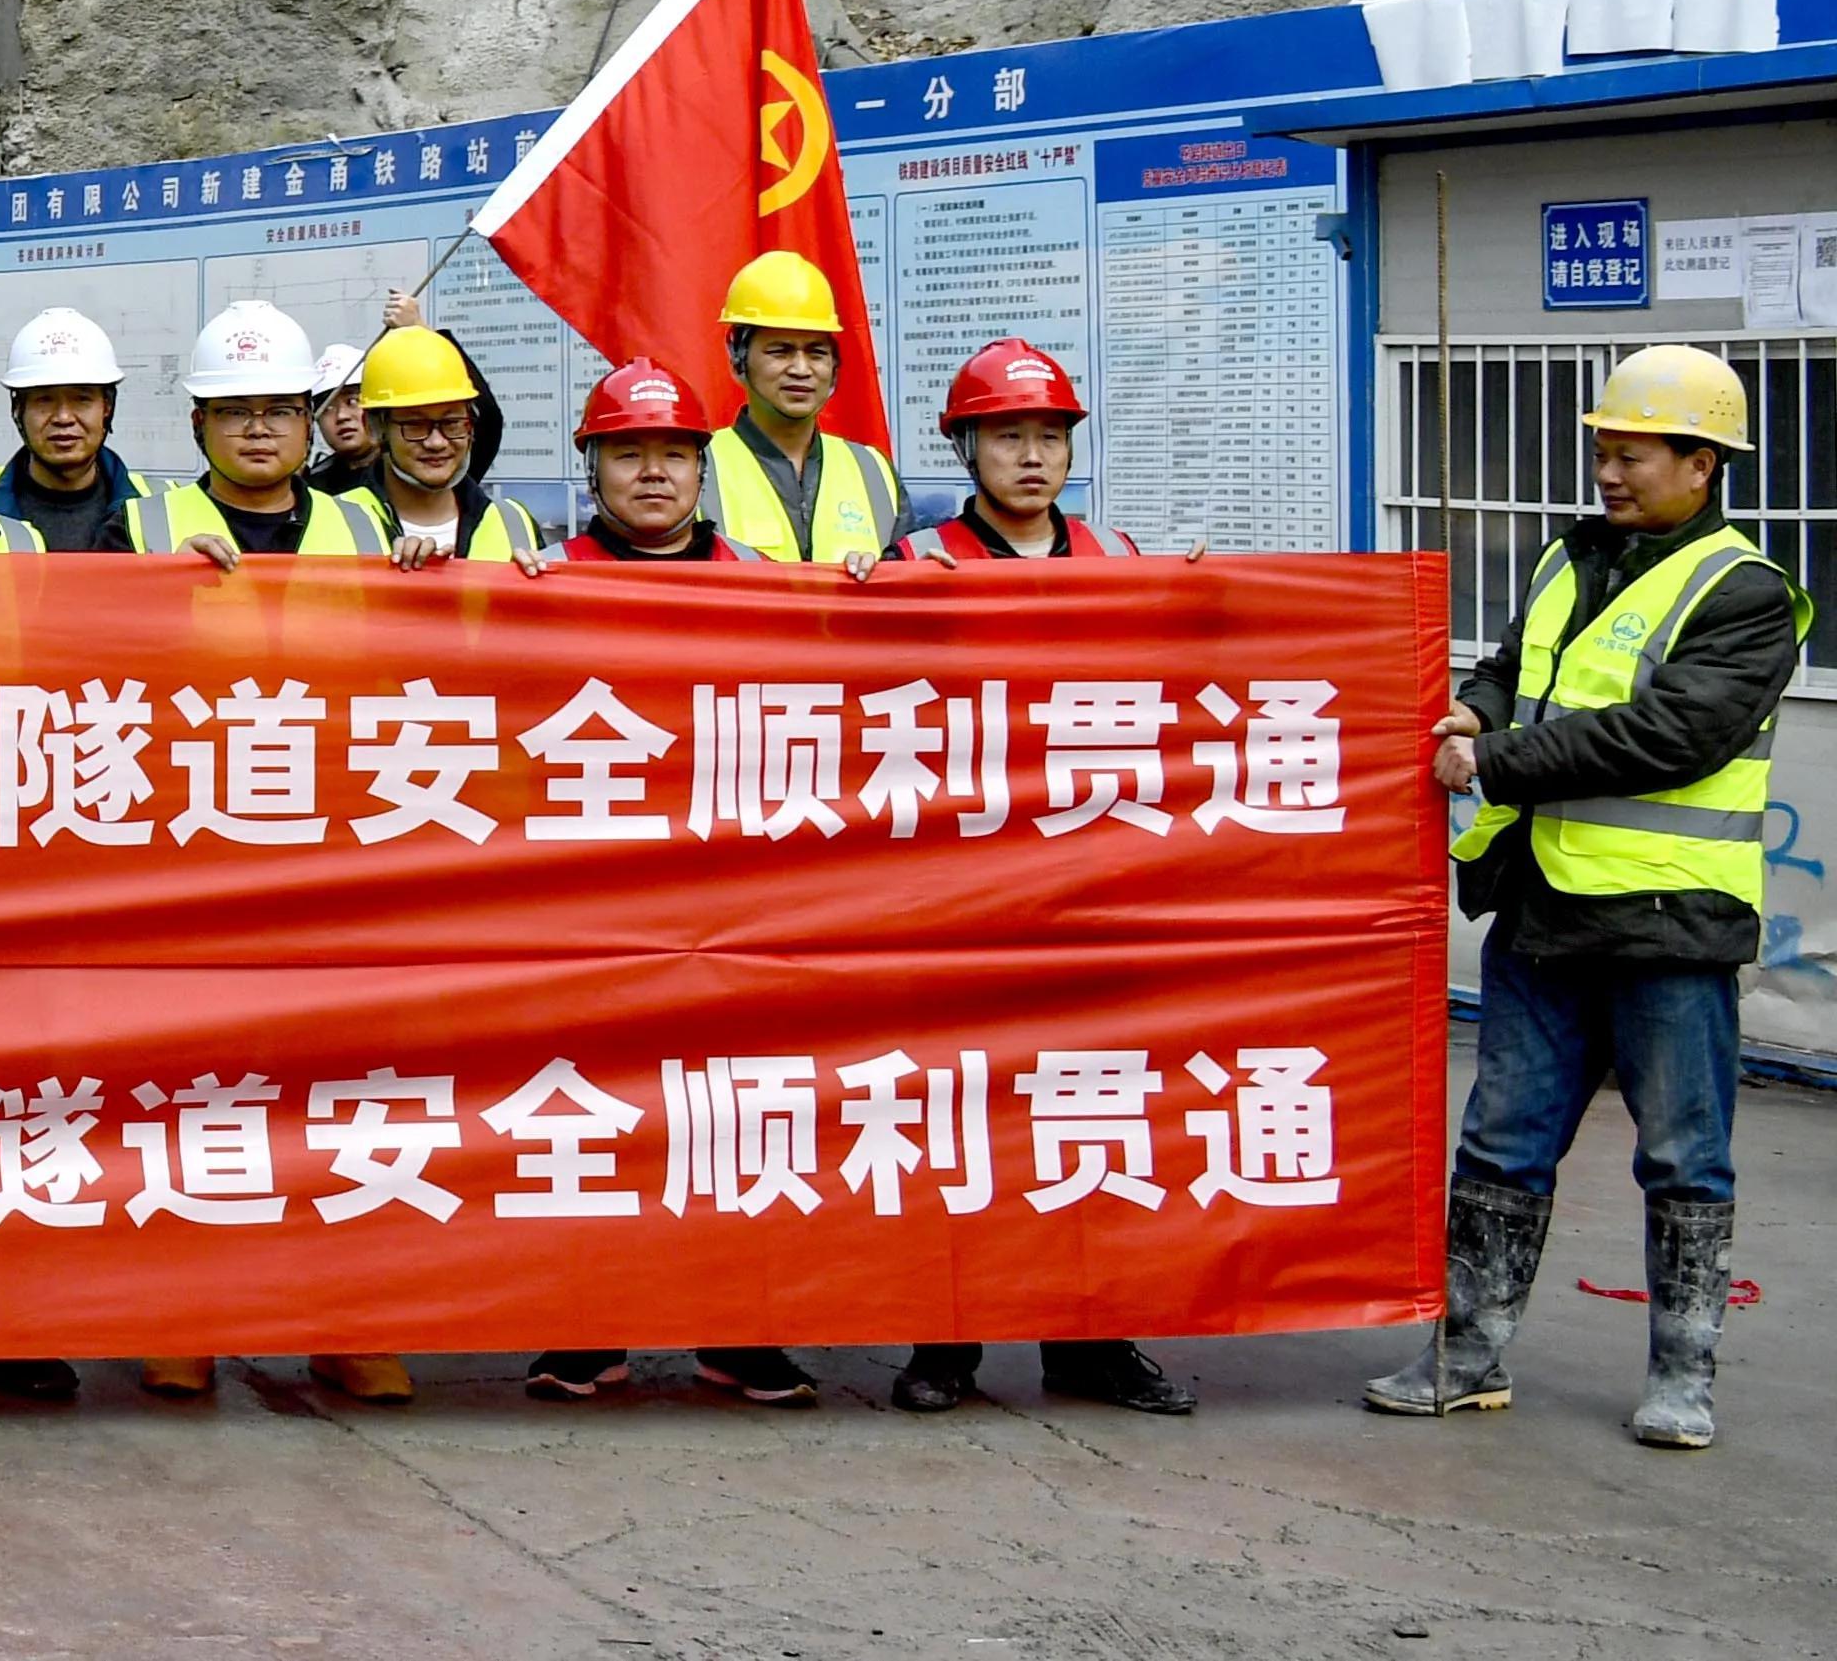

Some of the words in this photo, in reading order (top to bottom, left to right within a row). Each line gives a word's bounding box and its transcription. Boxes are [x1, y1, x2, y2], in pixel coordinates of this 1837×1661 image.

[855, 67, 1026, 120] 一分部
[1549, 220, 1640, 251] 进入现场
[1550, 258, 1642, 288] 请自觉登记
